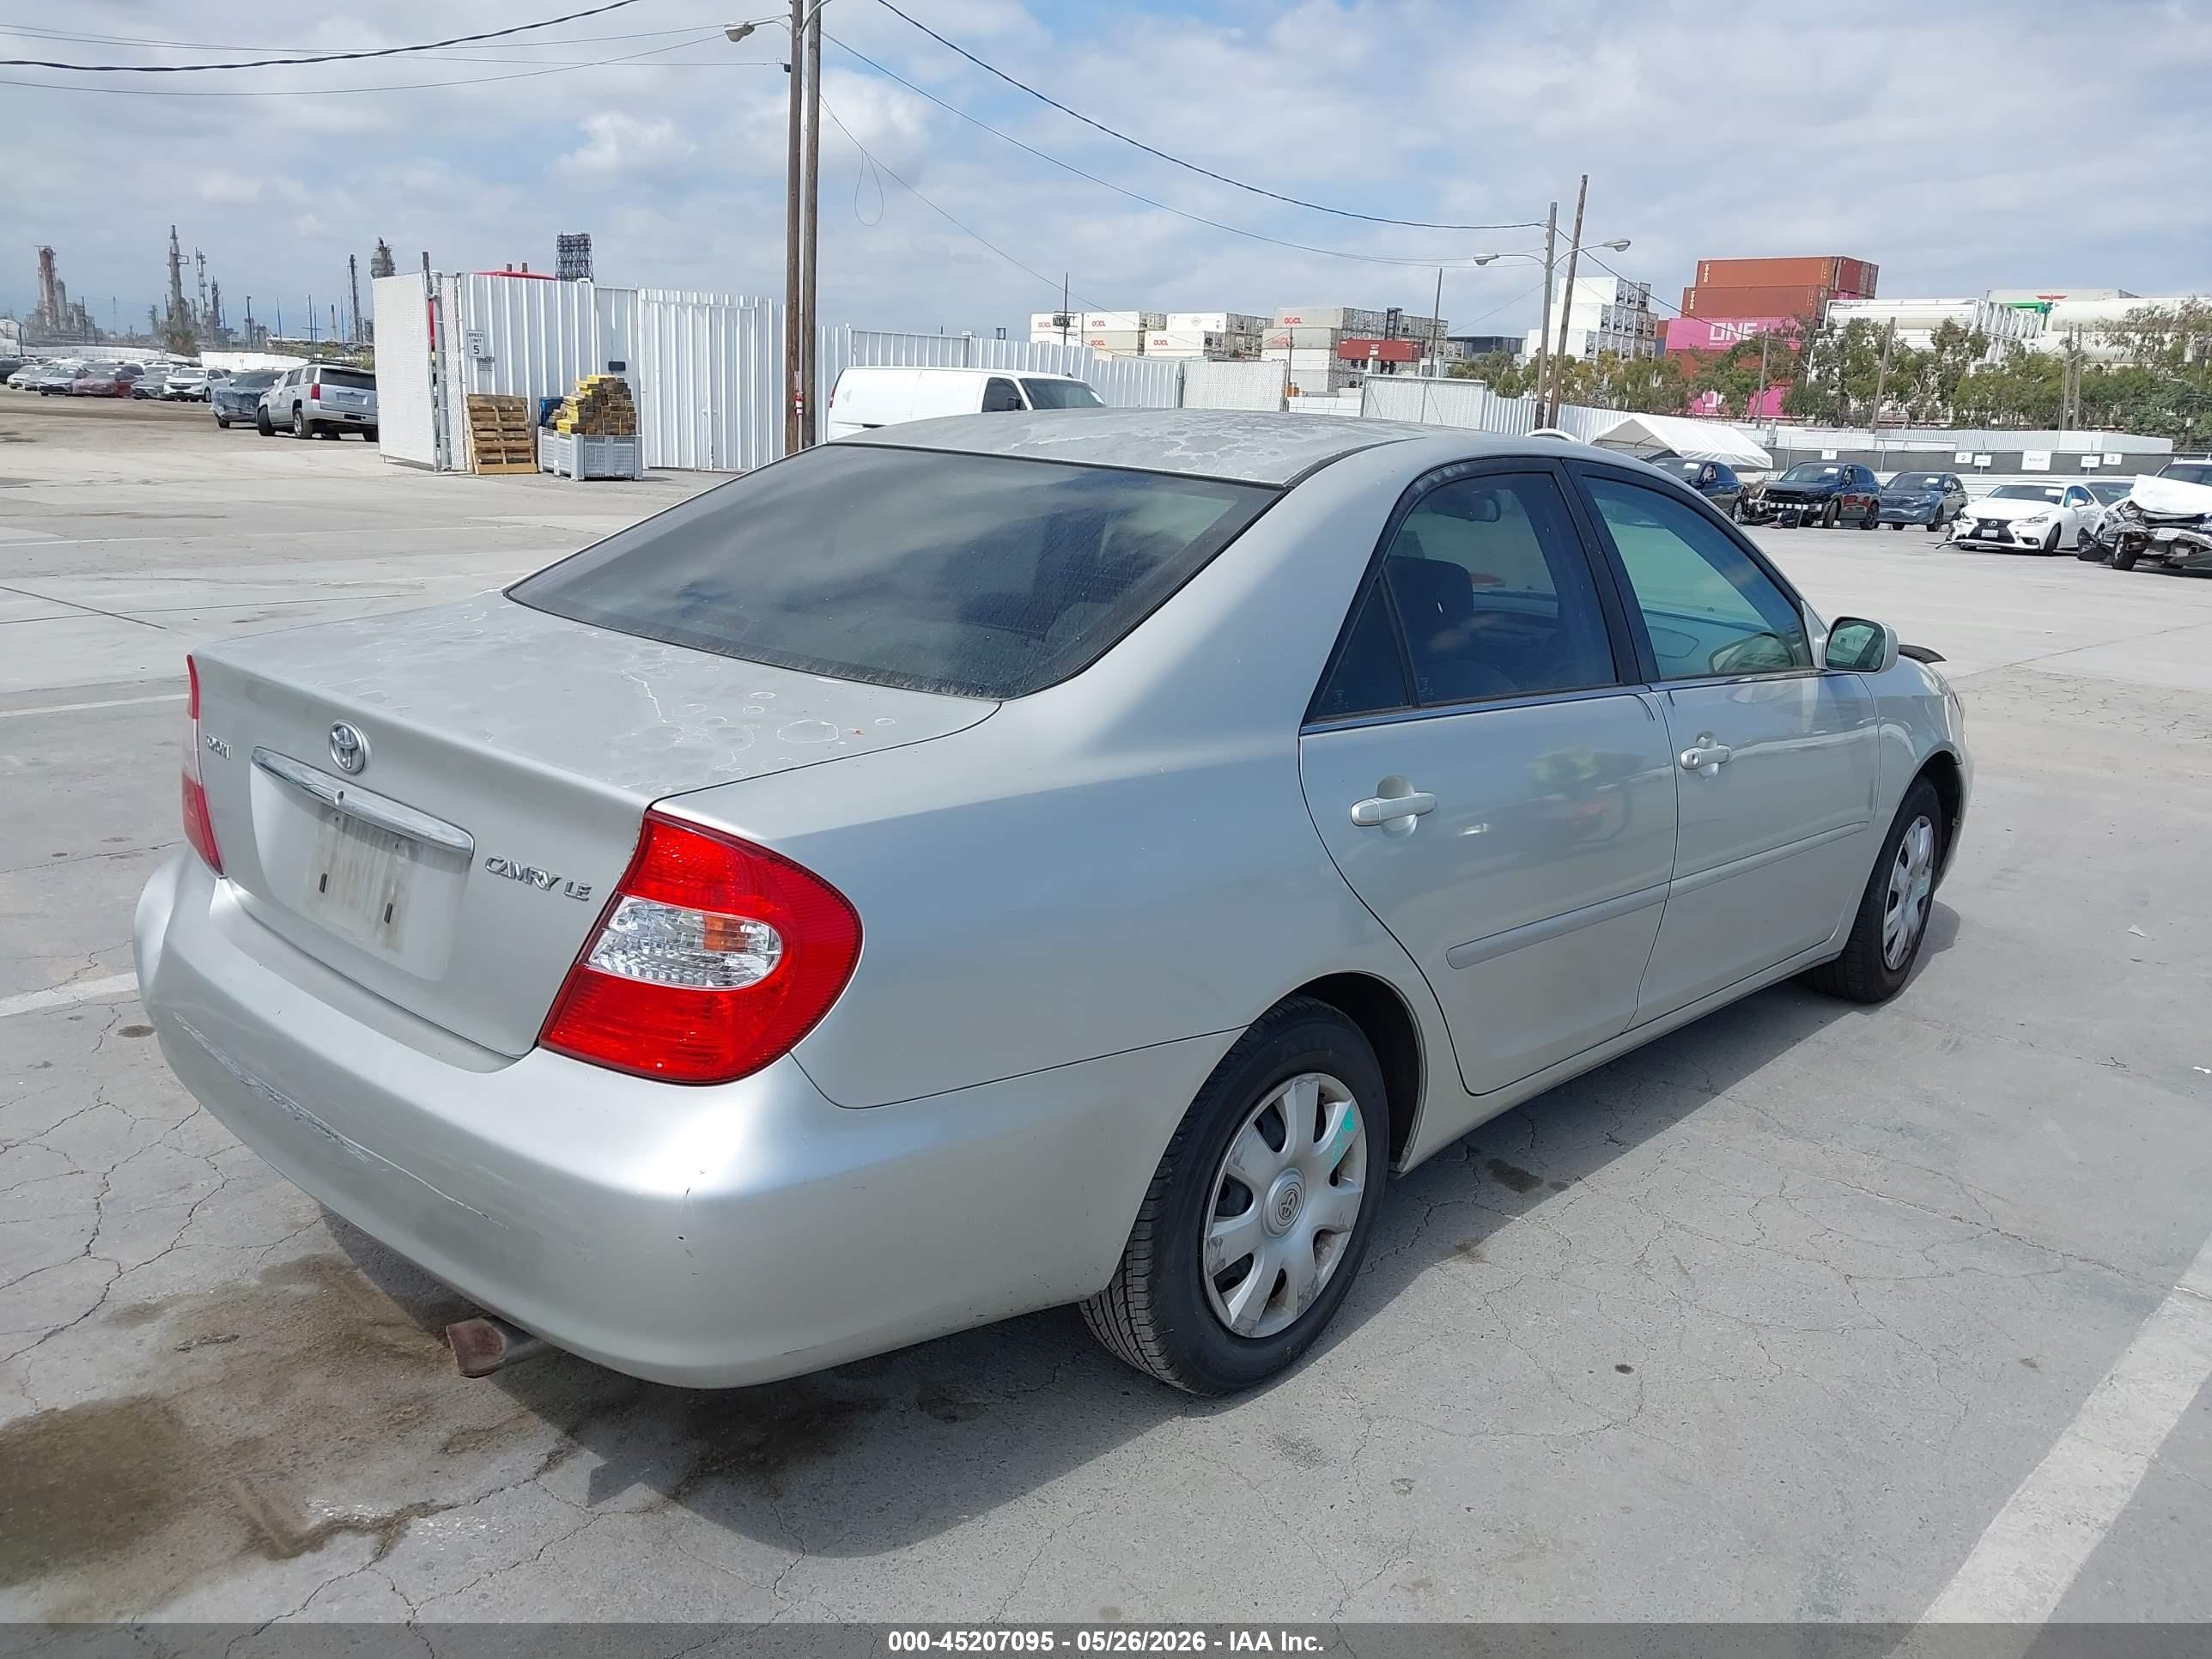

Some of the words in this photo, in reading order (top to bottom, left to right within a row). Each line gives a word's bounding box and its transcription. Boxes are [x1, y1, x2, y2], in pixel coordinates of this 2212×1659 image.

[1709, 322, 1759, 341] ONE
[473, 344, 480, 355] 5
[484, 857, 563, 891] CAMRY
[563, 880, 592, 902] LE
